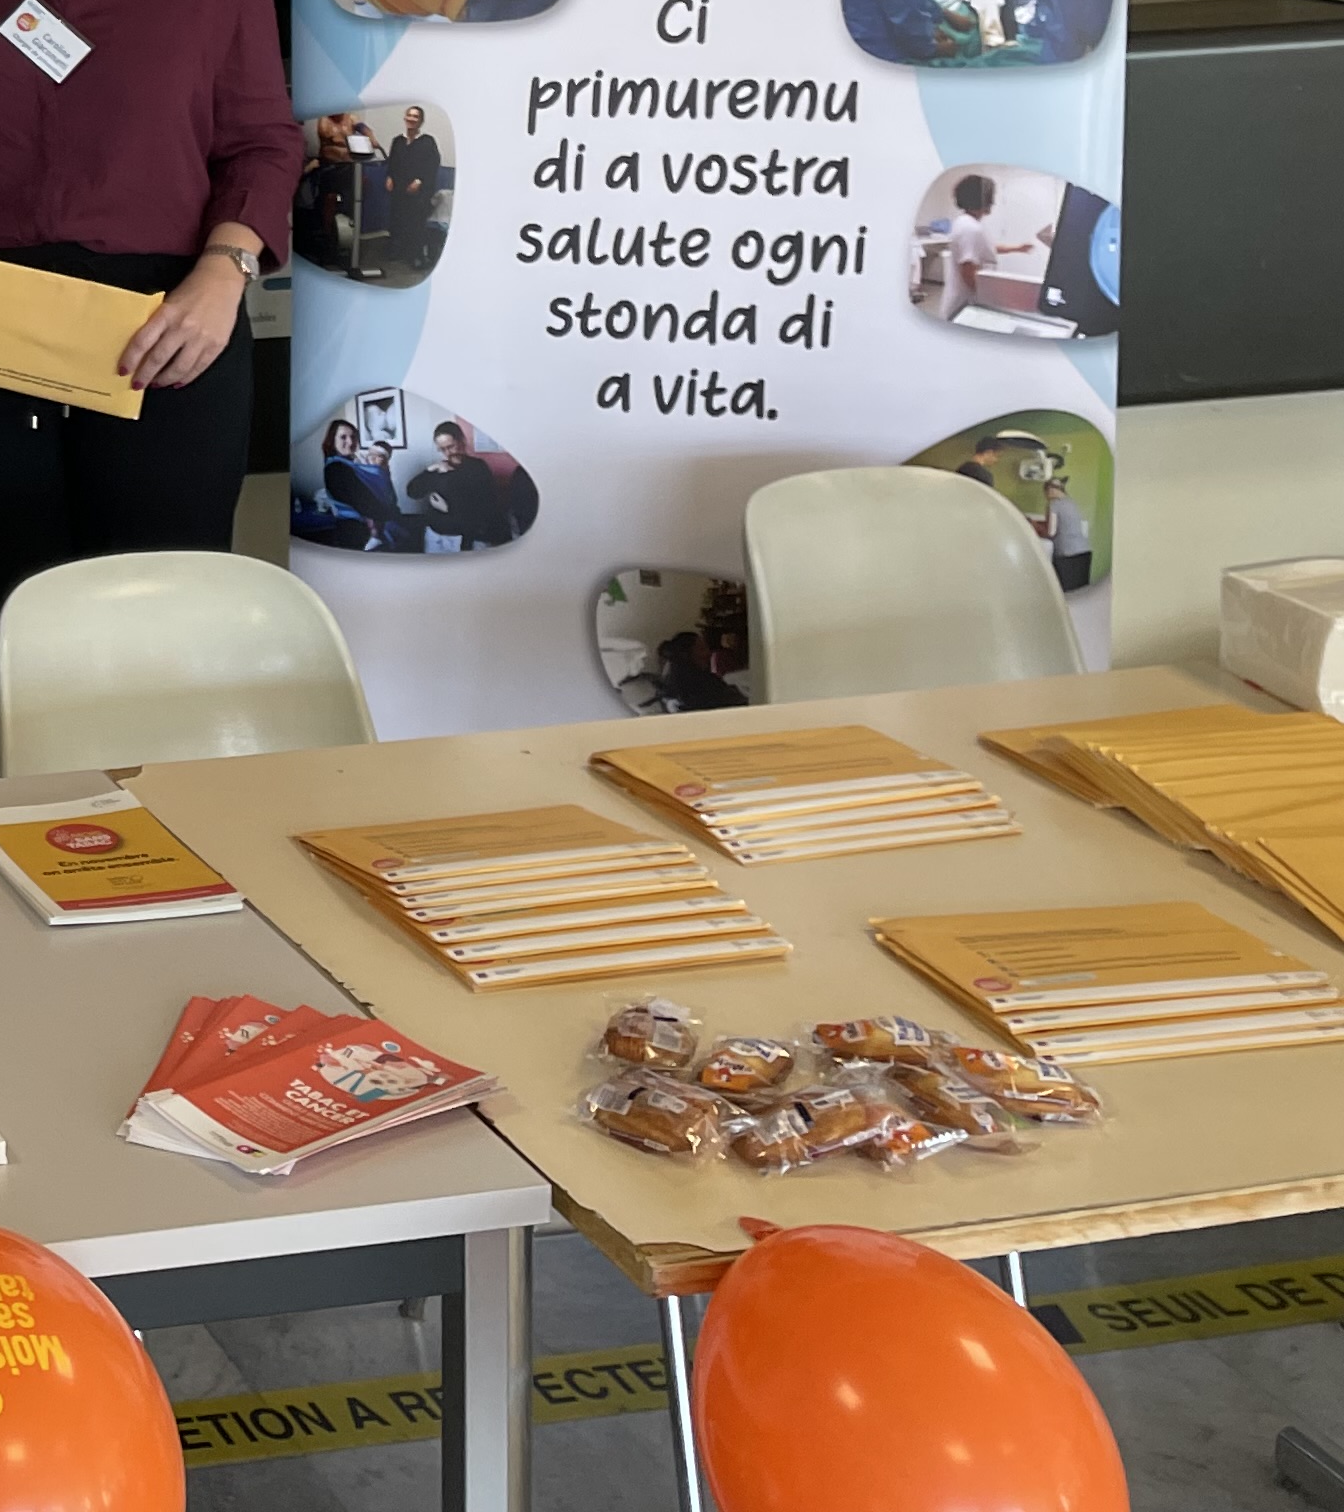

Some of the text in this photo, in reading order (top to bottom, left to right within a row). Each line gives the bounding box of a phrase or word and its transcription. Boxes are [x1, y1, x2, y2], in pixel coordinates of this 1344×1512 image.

[527, 69, 859, 136] primuremu
[533, 138, 849, 198] di a vostra
[515, 217, 868, 286] salute ogni
[545, 290, 835, 350] stonda di
[597, 368, 779, 421] a vita.
[43, 869, 62, 877] on
[58, 852, 149, 868] En novembre
[285, 1090, 356, 1125] CANCER
[289, 1079, 371, 1120] TABAC ET
[1087, 1289, 1250, 1333] SEUIL
[1234, 1277, 1329, 1312] DE
[346, 1396, 391, 1431] A
